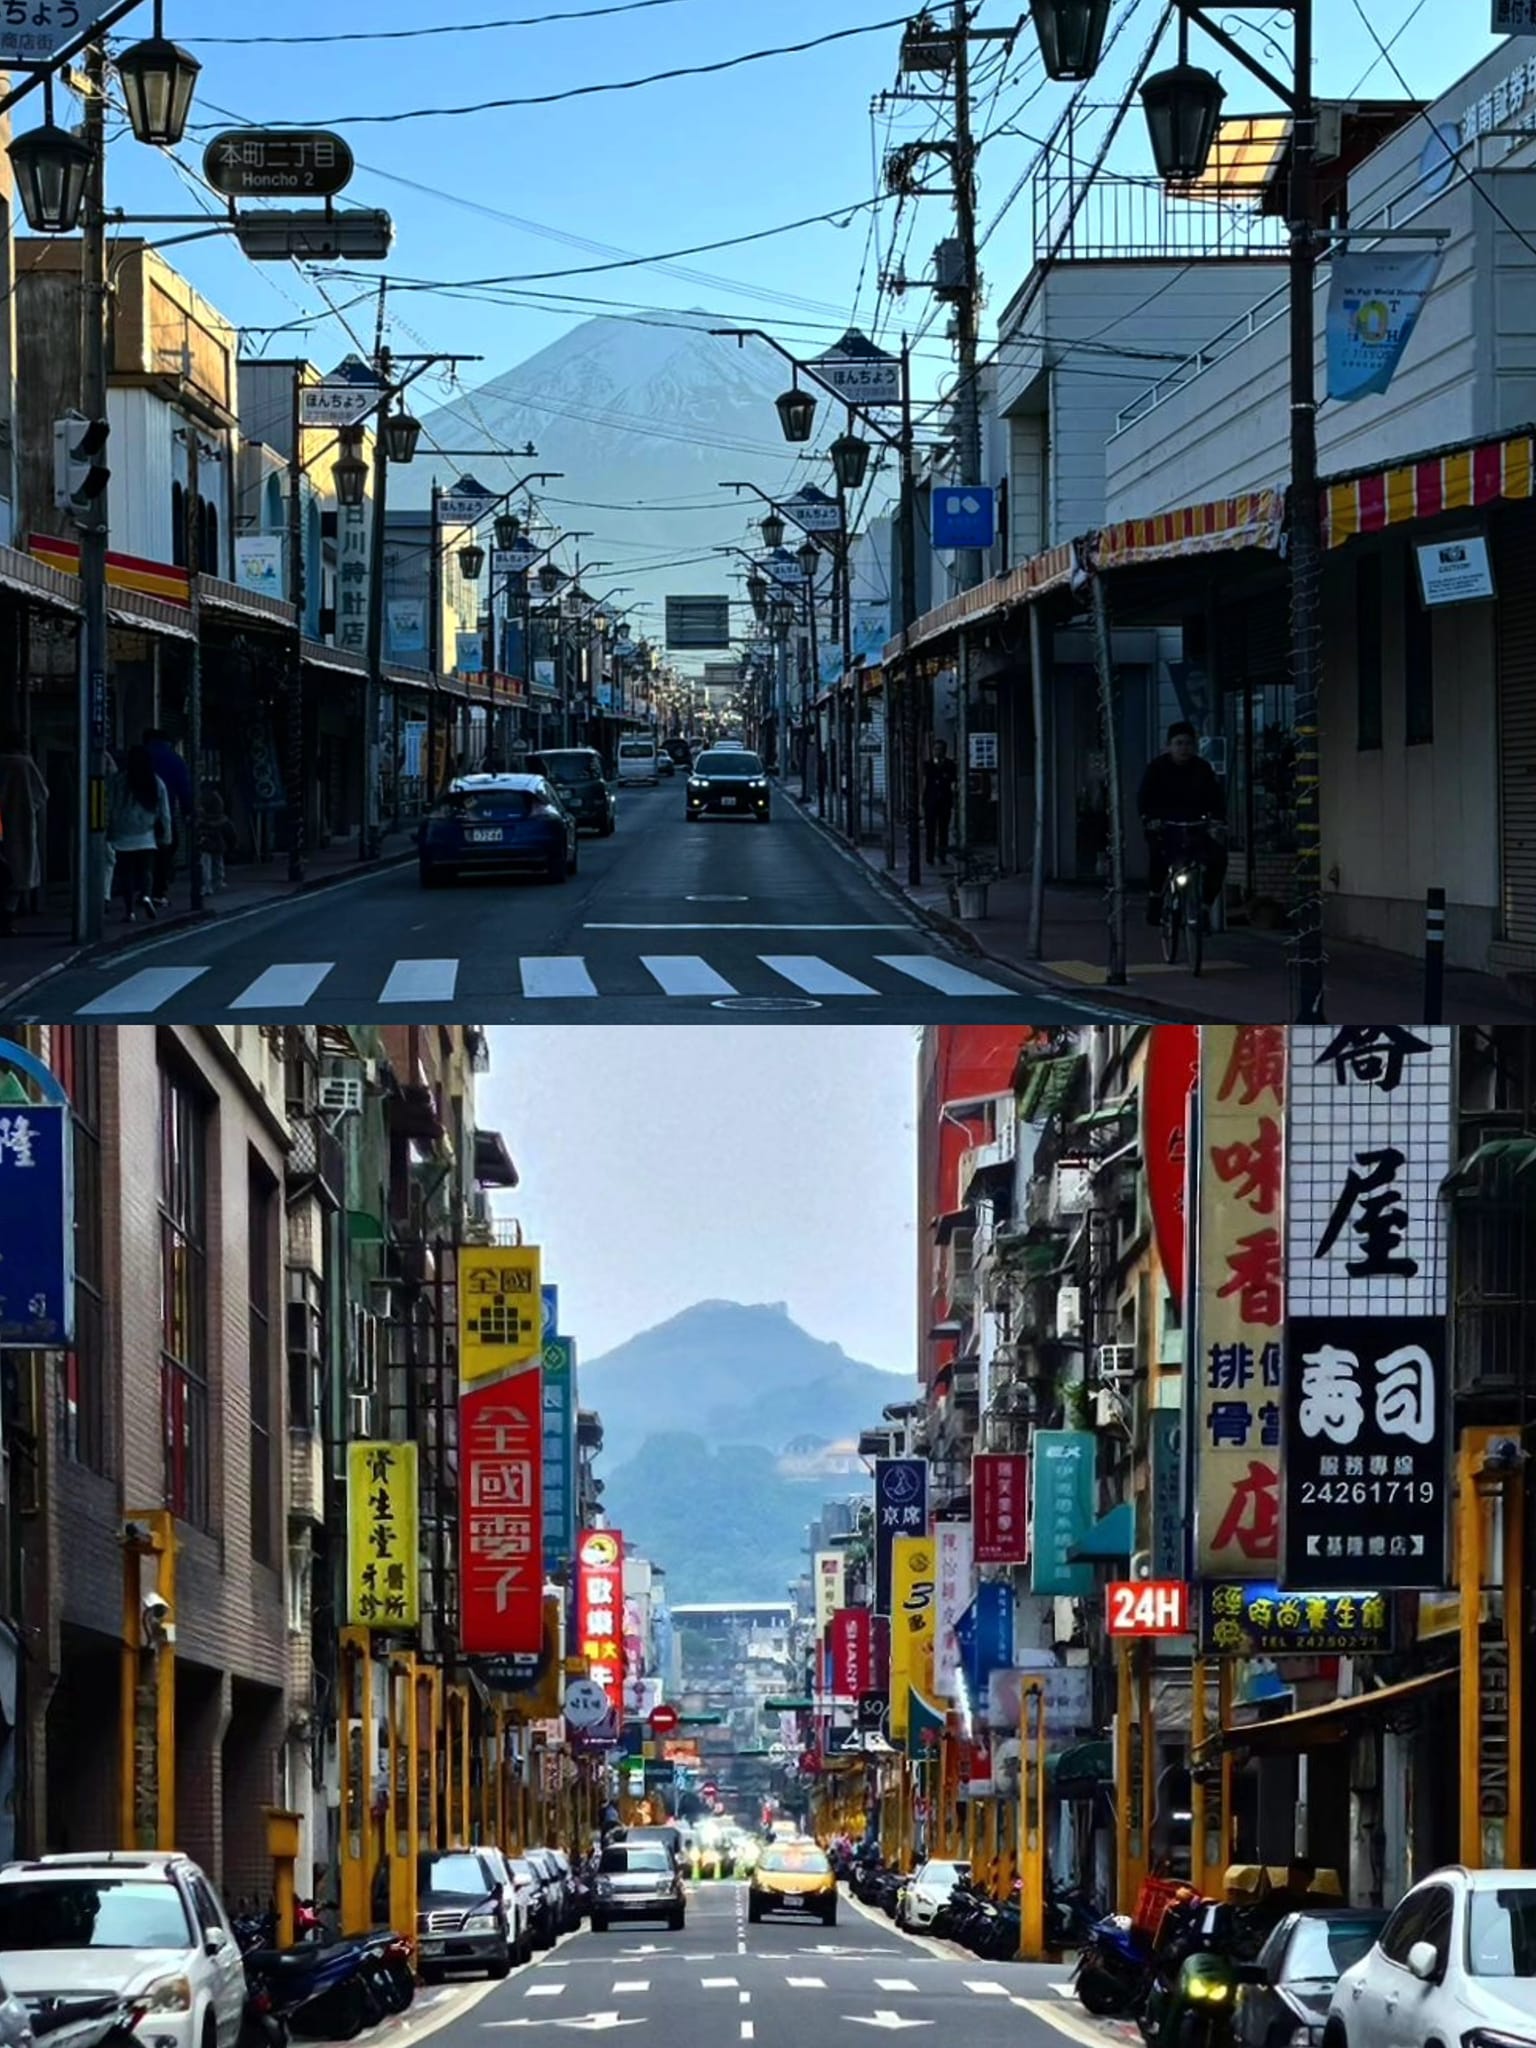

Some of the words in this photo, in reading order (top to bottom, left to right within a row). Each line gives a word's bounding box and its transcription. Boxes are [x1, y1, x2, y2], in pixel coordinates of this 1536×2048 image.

[0, 0, 80, 28] ちょう
[219, 140, 335, 168] 本町二丁目
[242, 172, 298, 186] Honcho
[304, 172, 314, 186] 2
[833, 371, 897, 385] ほんちょう
[306, 393, 367, 409] ほんちょう
[468, 1268, 531, 1294] 全國
[1301, 1481, 1434, 1504] 24261719
[470, 1406, 532, 1613] 全國電子
[1113, 1588, 1180, 1628] 24H
